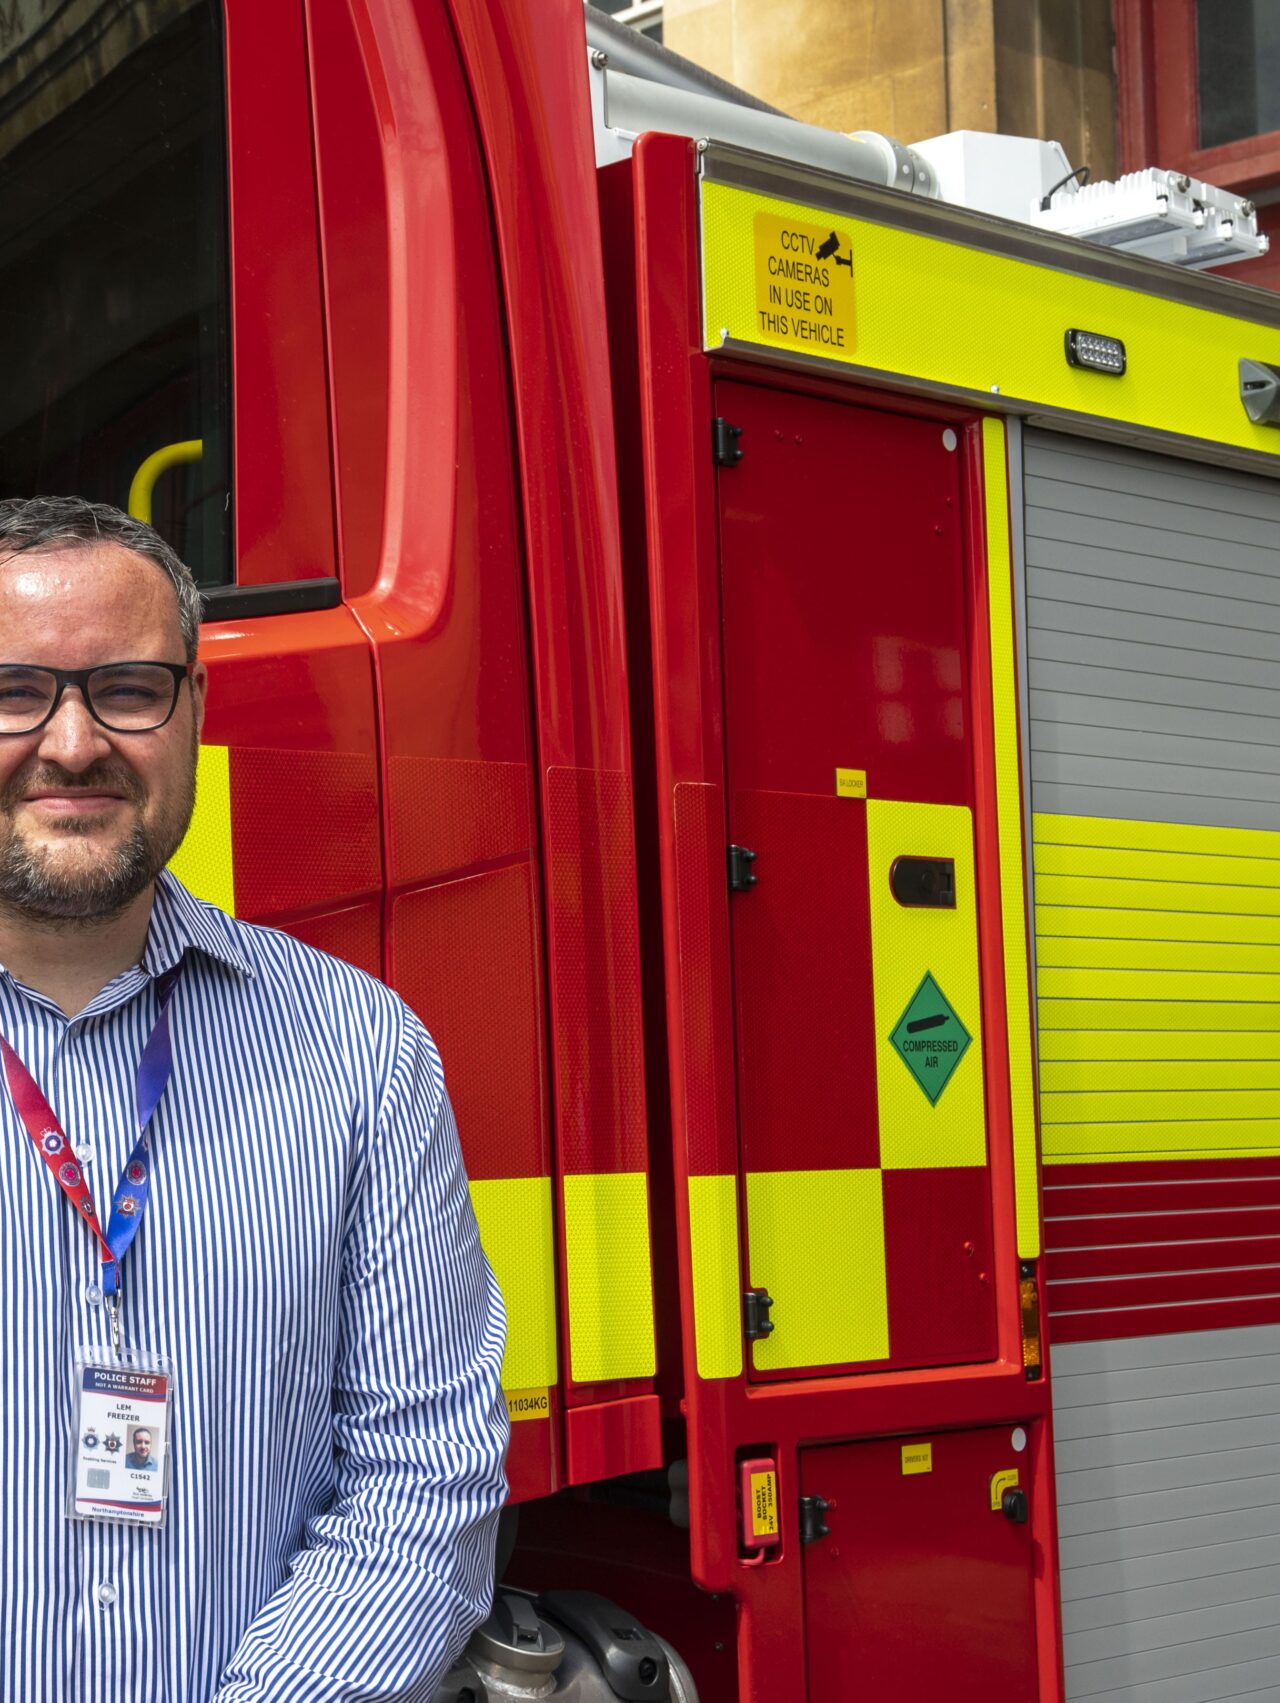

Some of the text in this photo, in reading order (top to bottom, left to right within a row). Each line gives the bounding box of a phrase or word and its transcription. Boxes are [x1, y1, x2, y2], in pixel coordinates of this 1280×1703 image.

[781, 230, 815, 255] CCTV
[768, 256, 830, 287] CAMERAS
[769, 285, 833, 316] IN USE ON
[759, 311, 845, 347] THIS VEHICLE
[903, 1040, 959, 1052] COMPRESSED
[925, 1056, 939, 1068] AIR
[94, 1371, 157, 1387] POLICE STAFF
[113, 1384, 139, 1392] WARRANT
[116, 1403, 132, 1411] LEM
[508, 1396, 548, 1412] 11034KG
[107, 1412, 140, 1422] FREEZER
[130, 1472, 151, 1481] C1542
[91, 1506, 145, 1518] Northamptonshire
